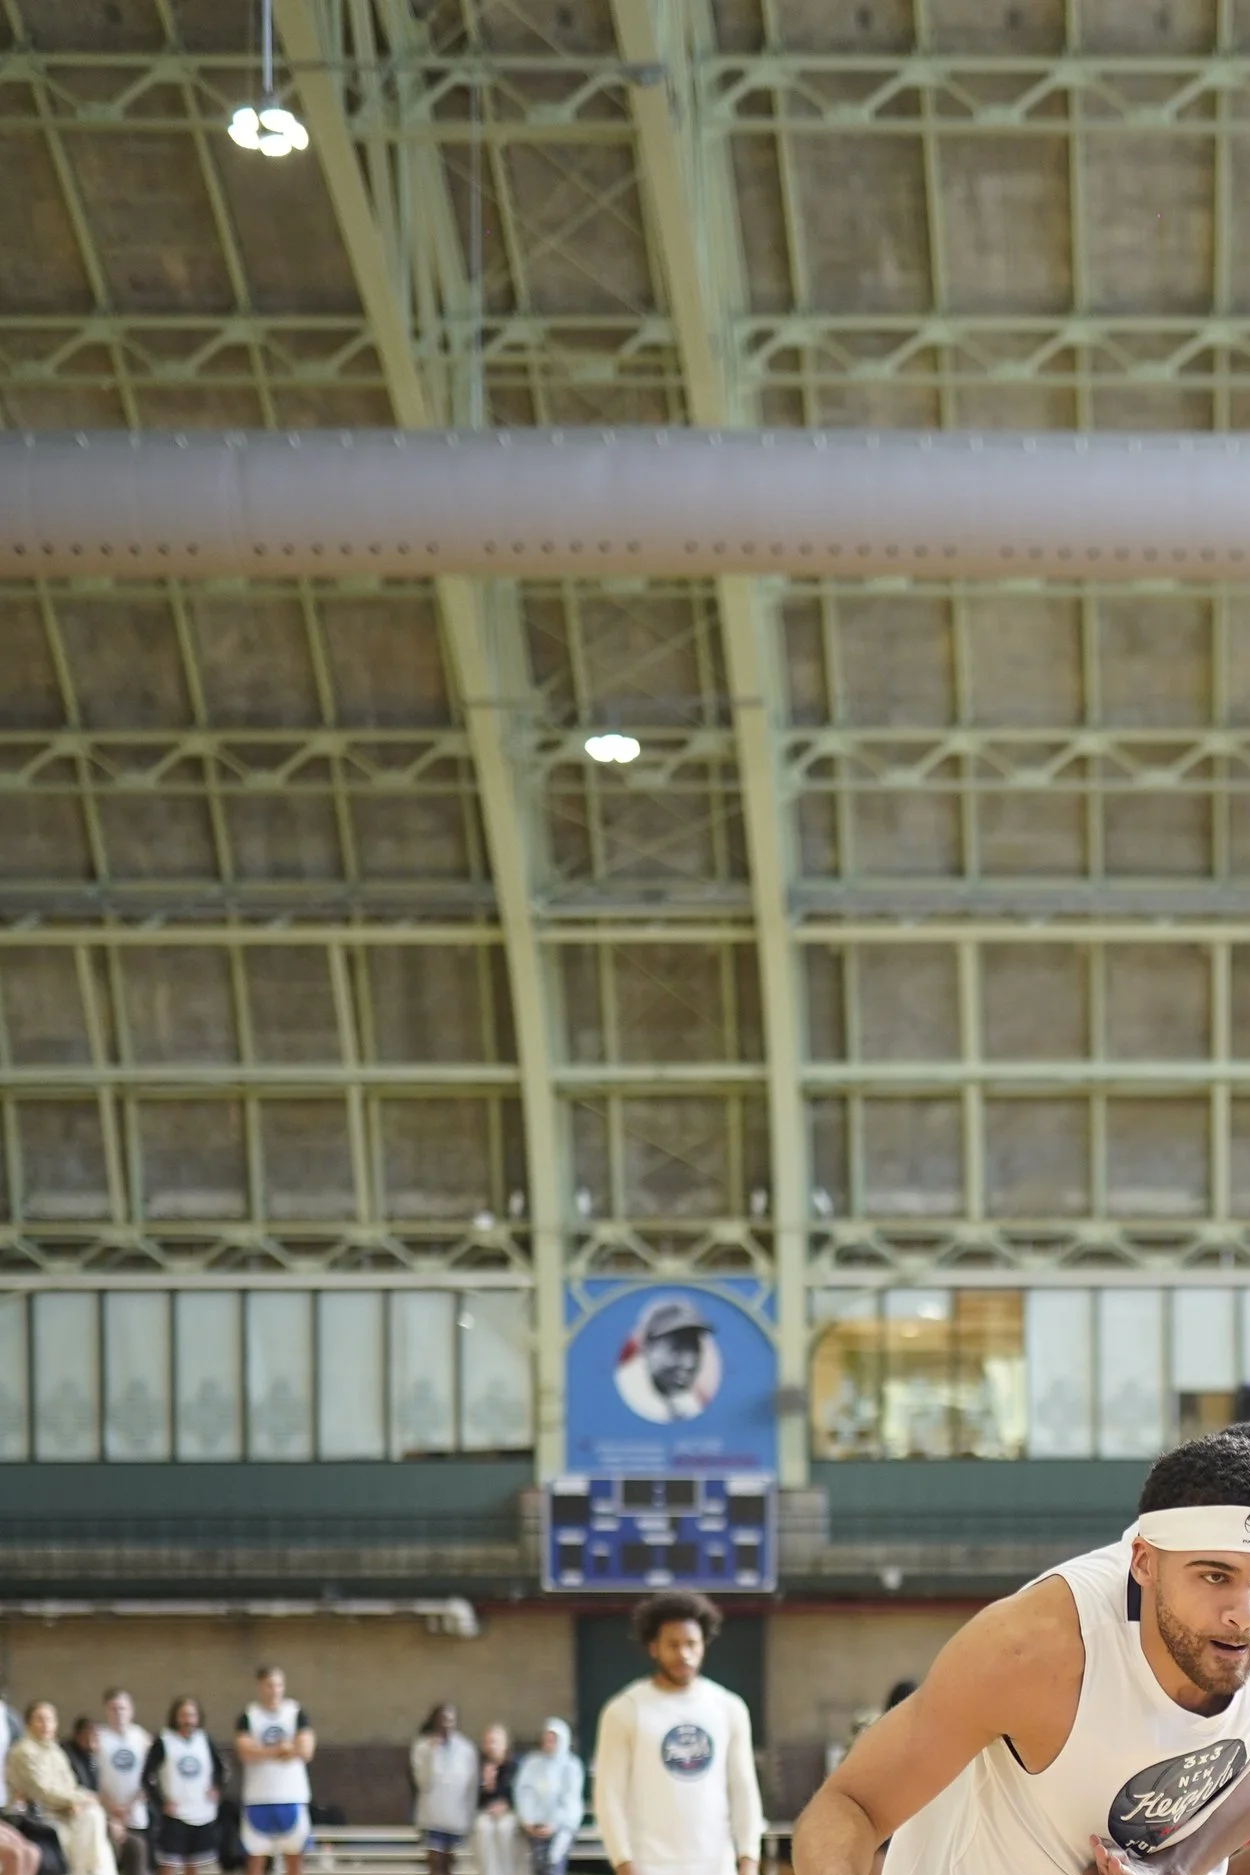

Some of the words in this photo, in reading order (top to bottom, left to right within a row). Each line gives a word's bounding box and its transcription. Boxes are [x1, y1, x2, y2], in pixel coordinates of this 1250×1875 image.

[1183, 1746, 1223, 1769] 3x3
[1120, 1745, 1241, 1824] Heights
[1178, 1766, 1215, 1788] NEW
